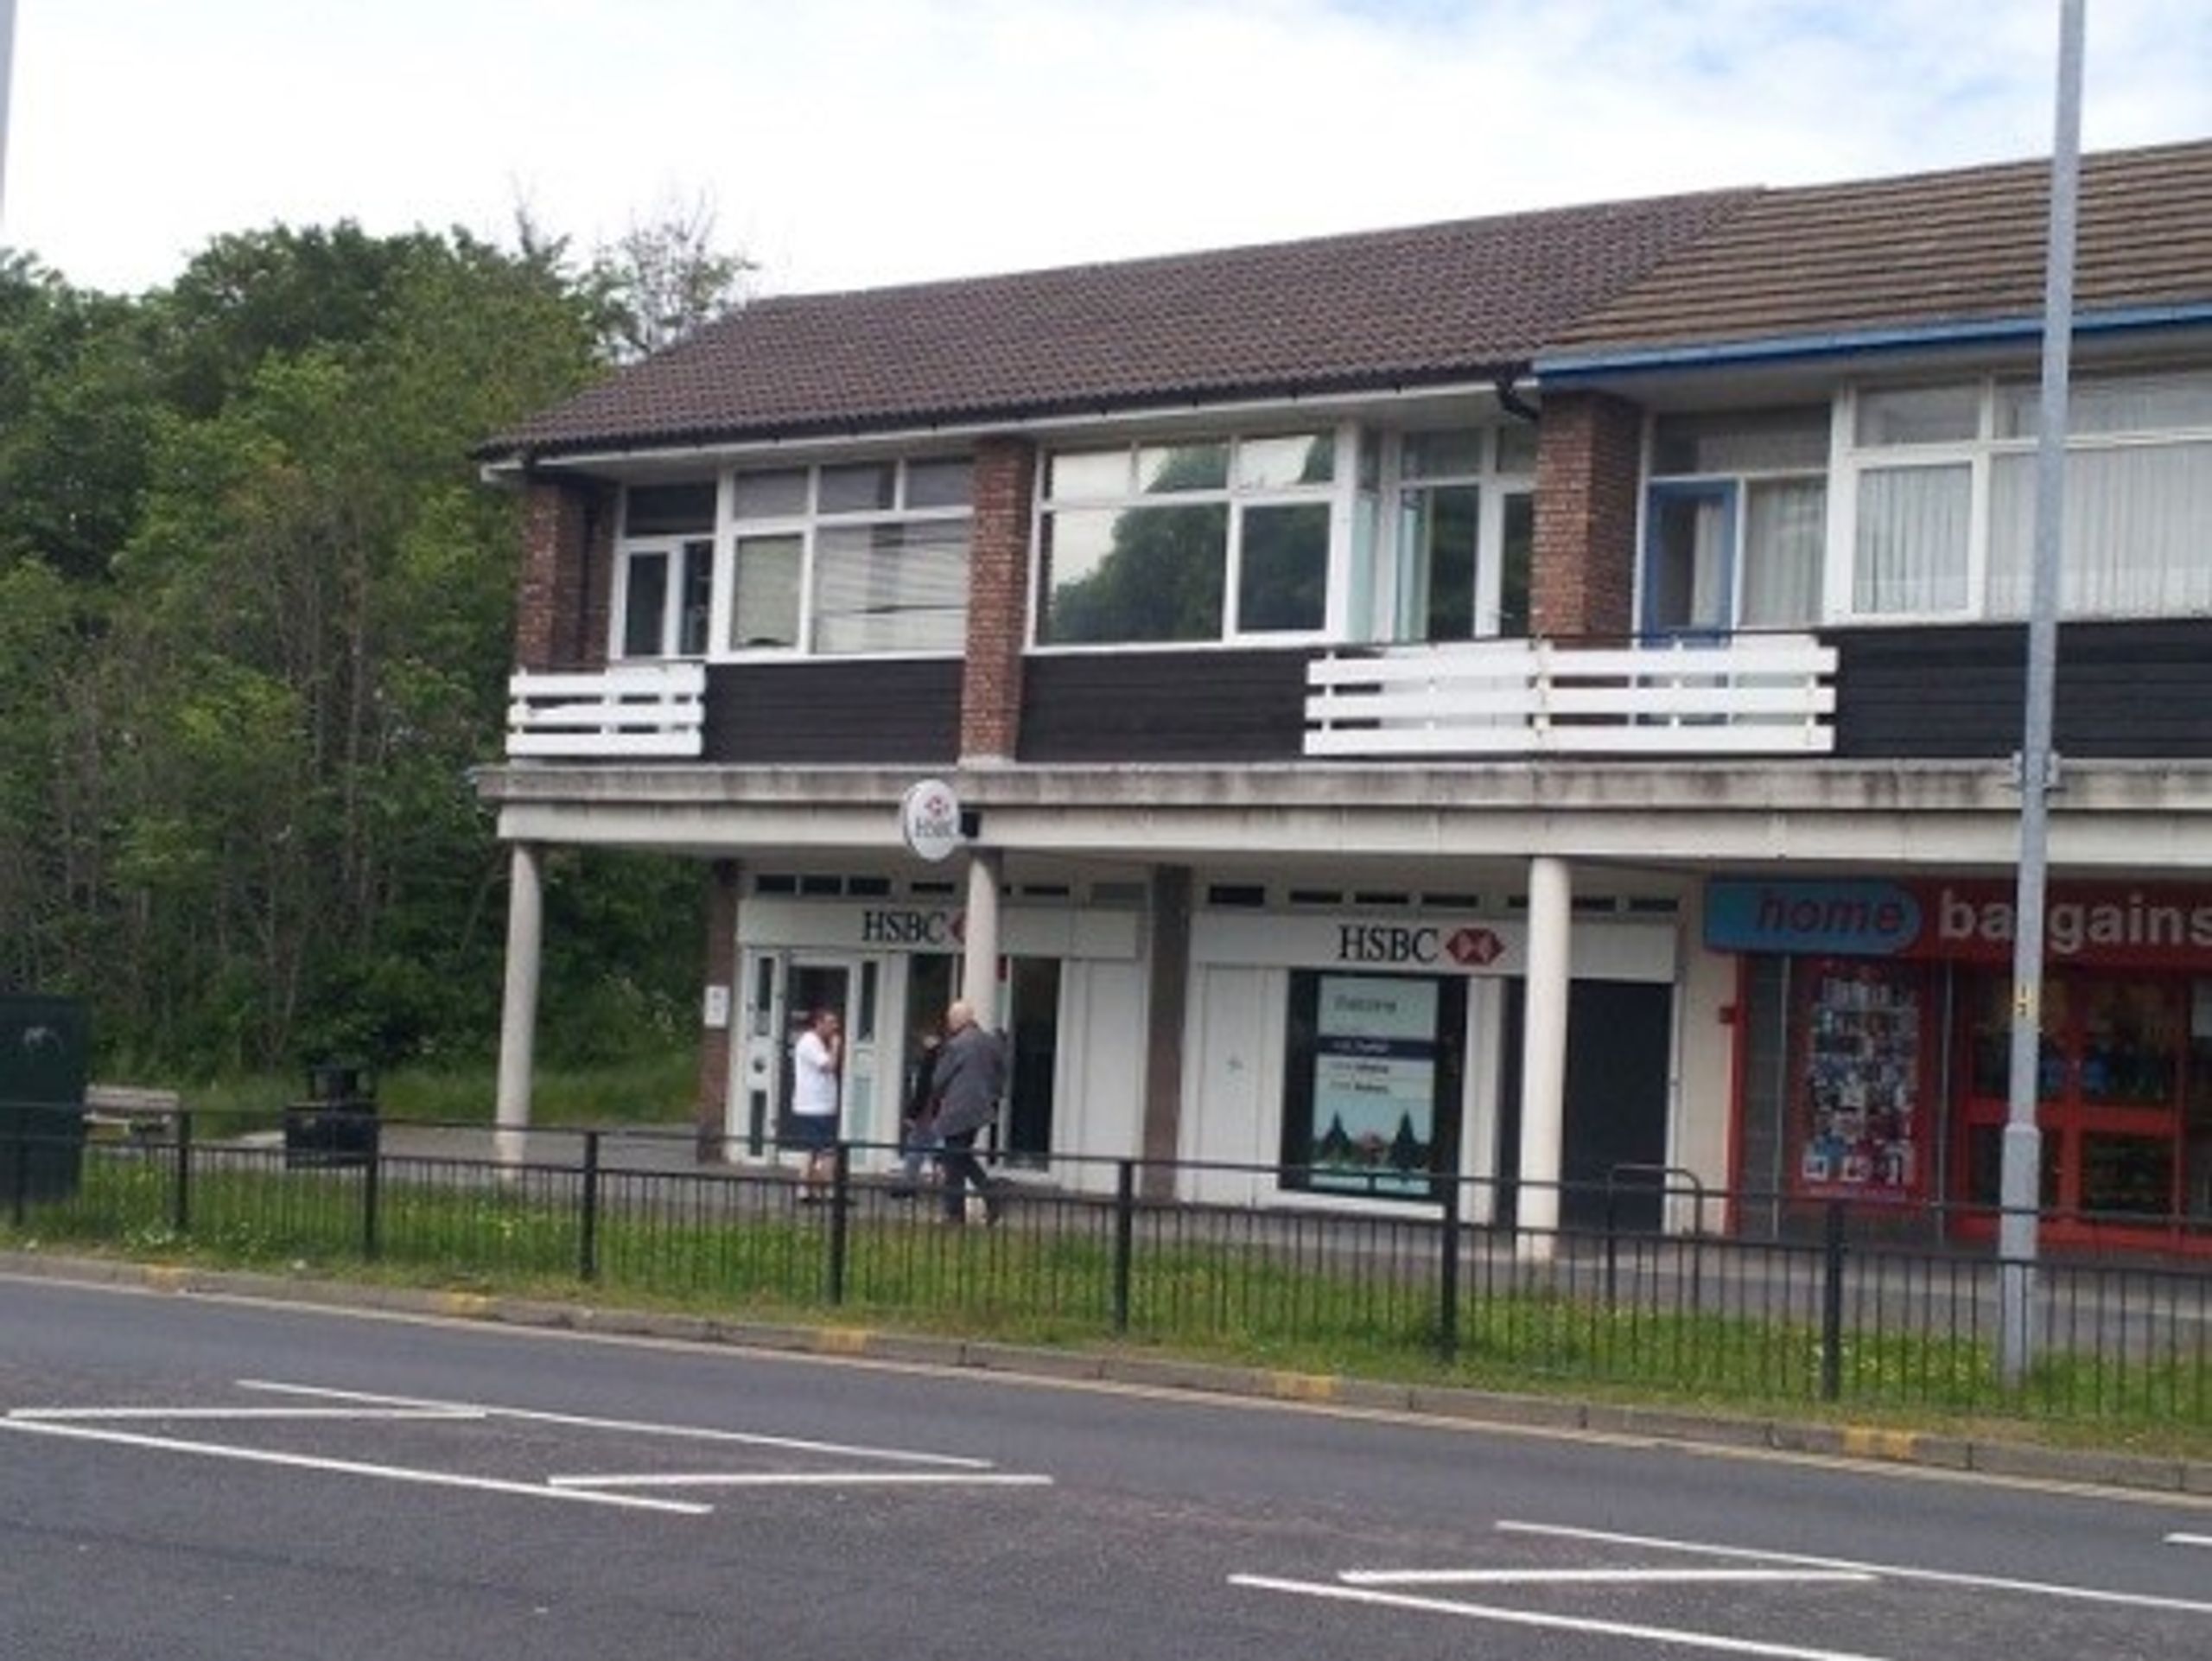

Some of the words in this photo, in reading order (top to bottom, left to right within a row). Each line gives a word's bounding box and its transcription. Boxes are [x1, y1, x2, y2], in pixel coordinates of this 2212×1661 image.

[862, 910, 947, 944] HSBC
[1756, 887, 1905, 935] home
[1939, 888, 2212, 953] bagains
[1338, 924, 1439, 964] HSBC
